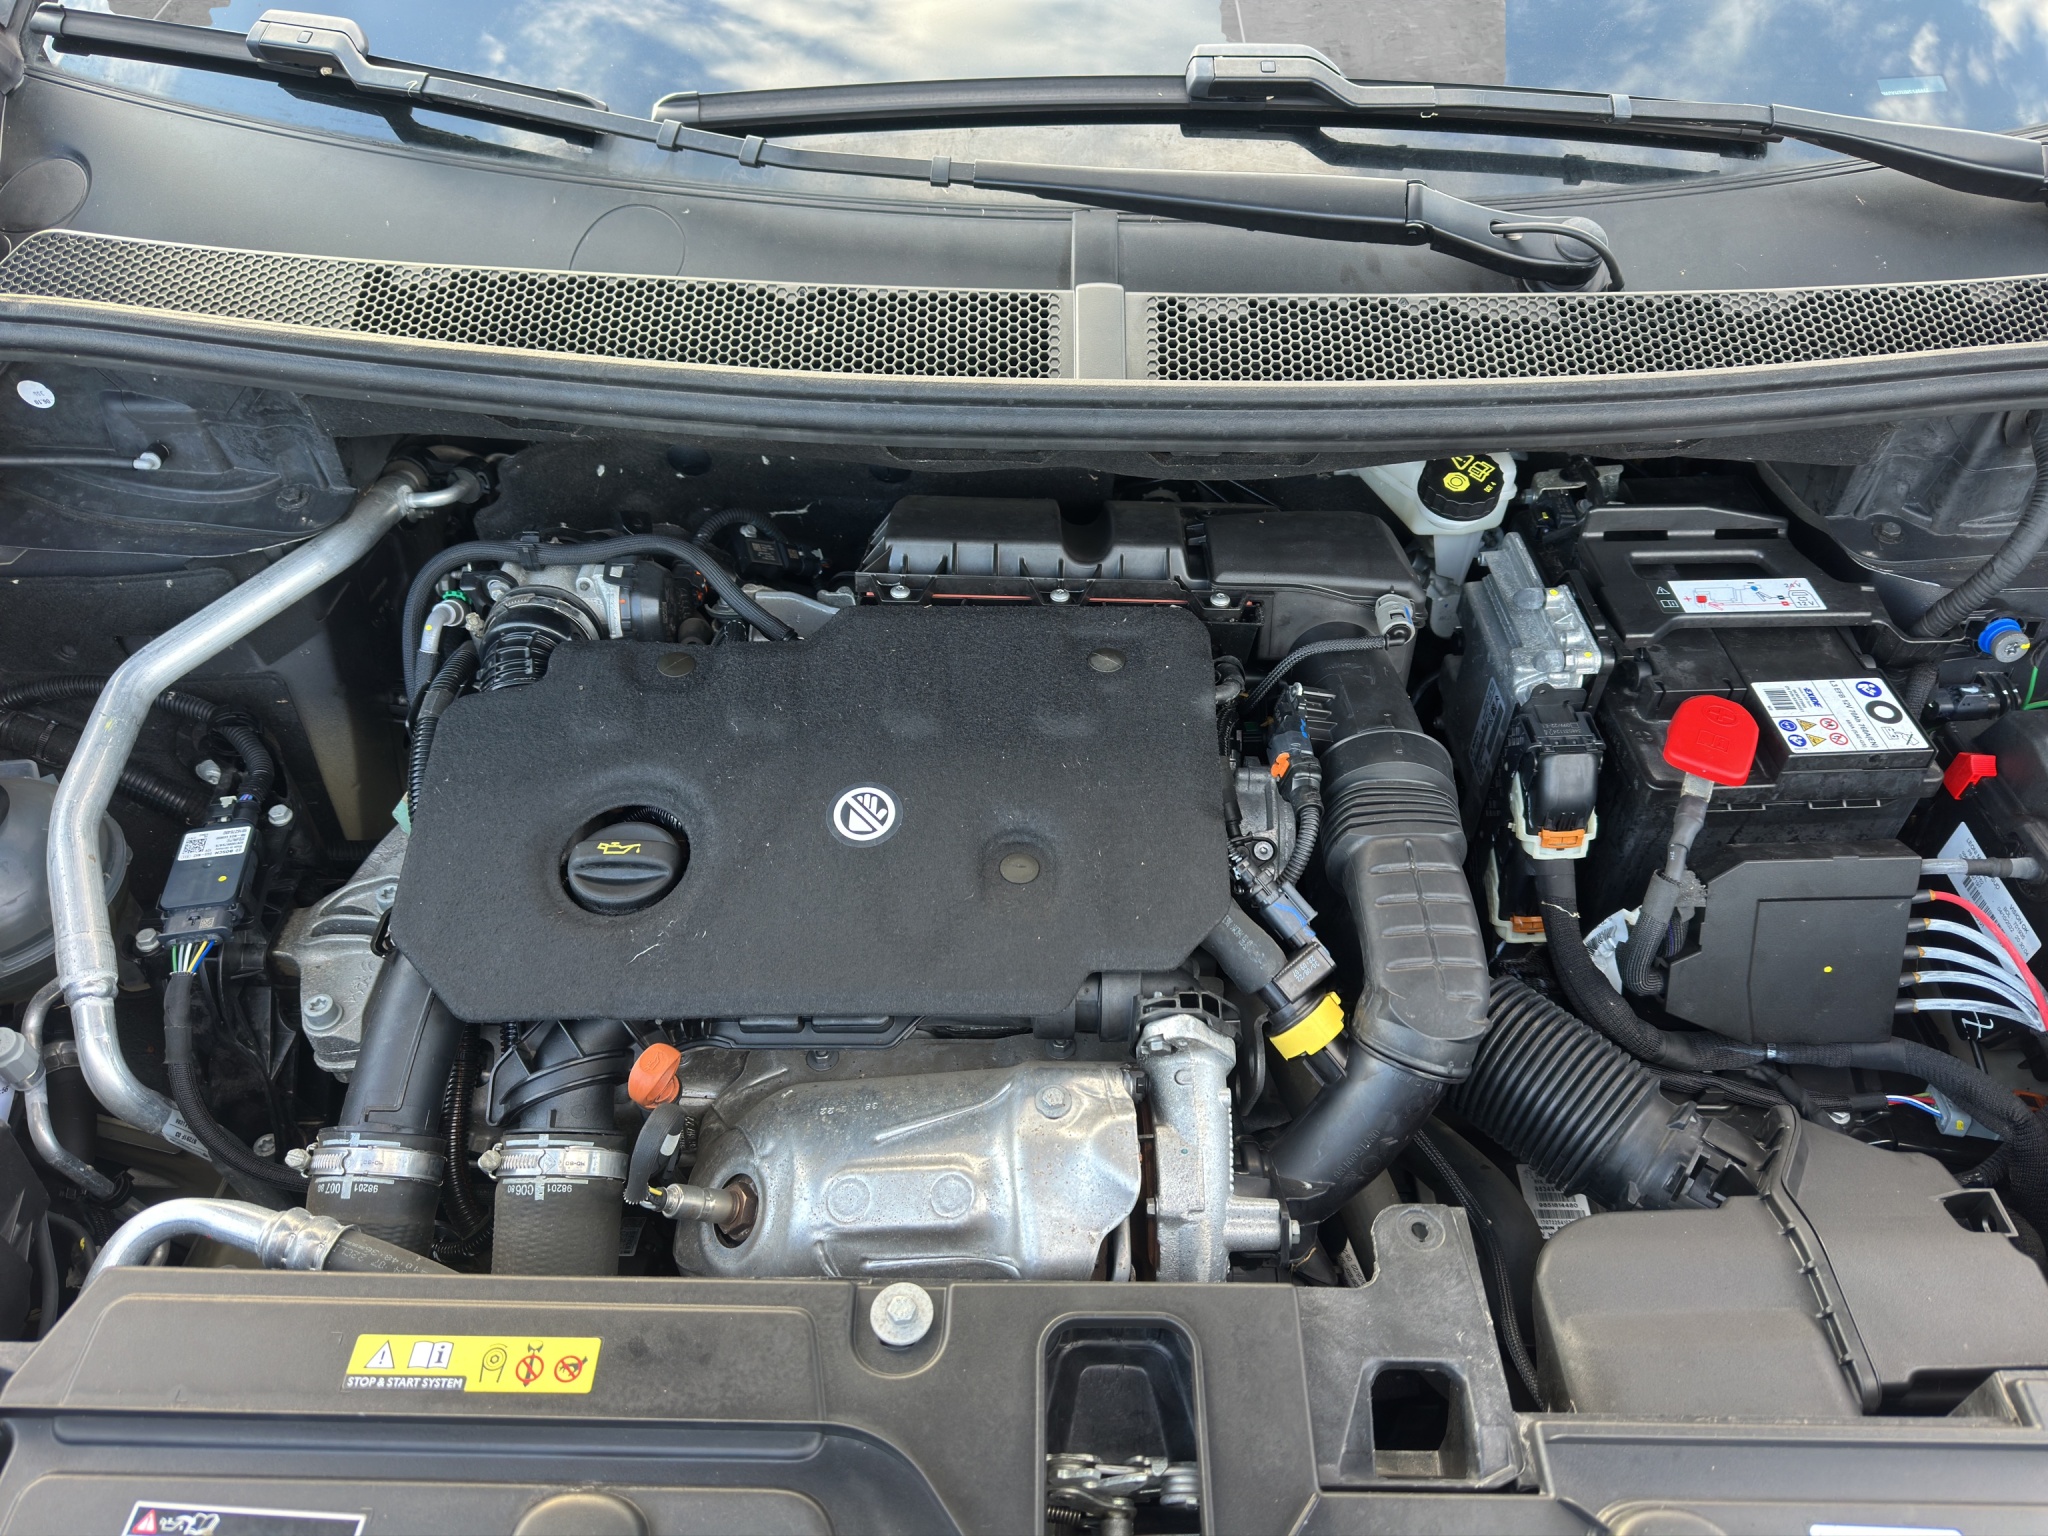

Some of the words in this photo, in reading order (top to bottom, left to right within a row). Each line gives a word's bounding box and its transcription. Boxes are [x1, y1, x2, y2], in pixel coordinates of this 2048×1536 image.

[1803, 687, 1823, 709] EXIDE
[2009, 904, 2023, 925] VISION
[2021, 923, 2030, 934] OK
[325, 1182, 341, 1195] 007
[353, 1182, 379, 1194] 98201
[546, 1183, 573, 1193] 98201
[346, 1375, 377, 1388] STOP
[376, 1377, 386, 1388] &
[386, 1376, 419, 1389] START
[421, 1377, 464, 1389] SYSTEM
